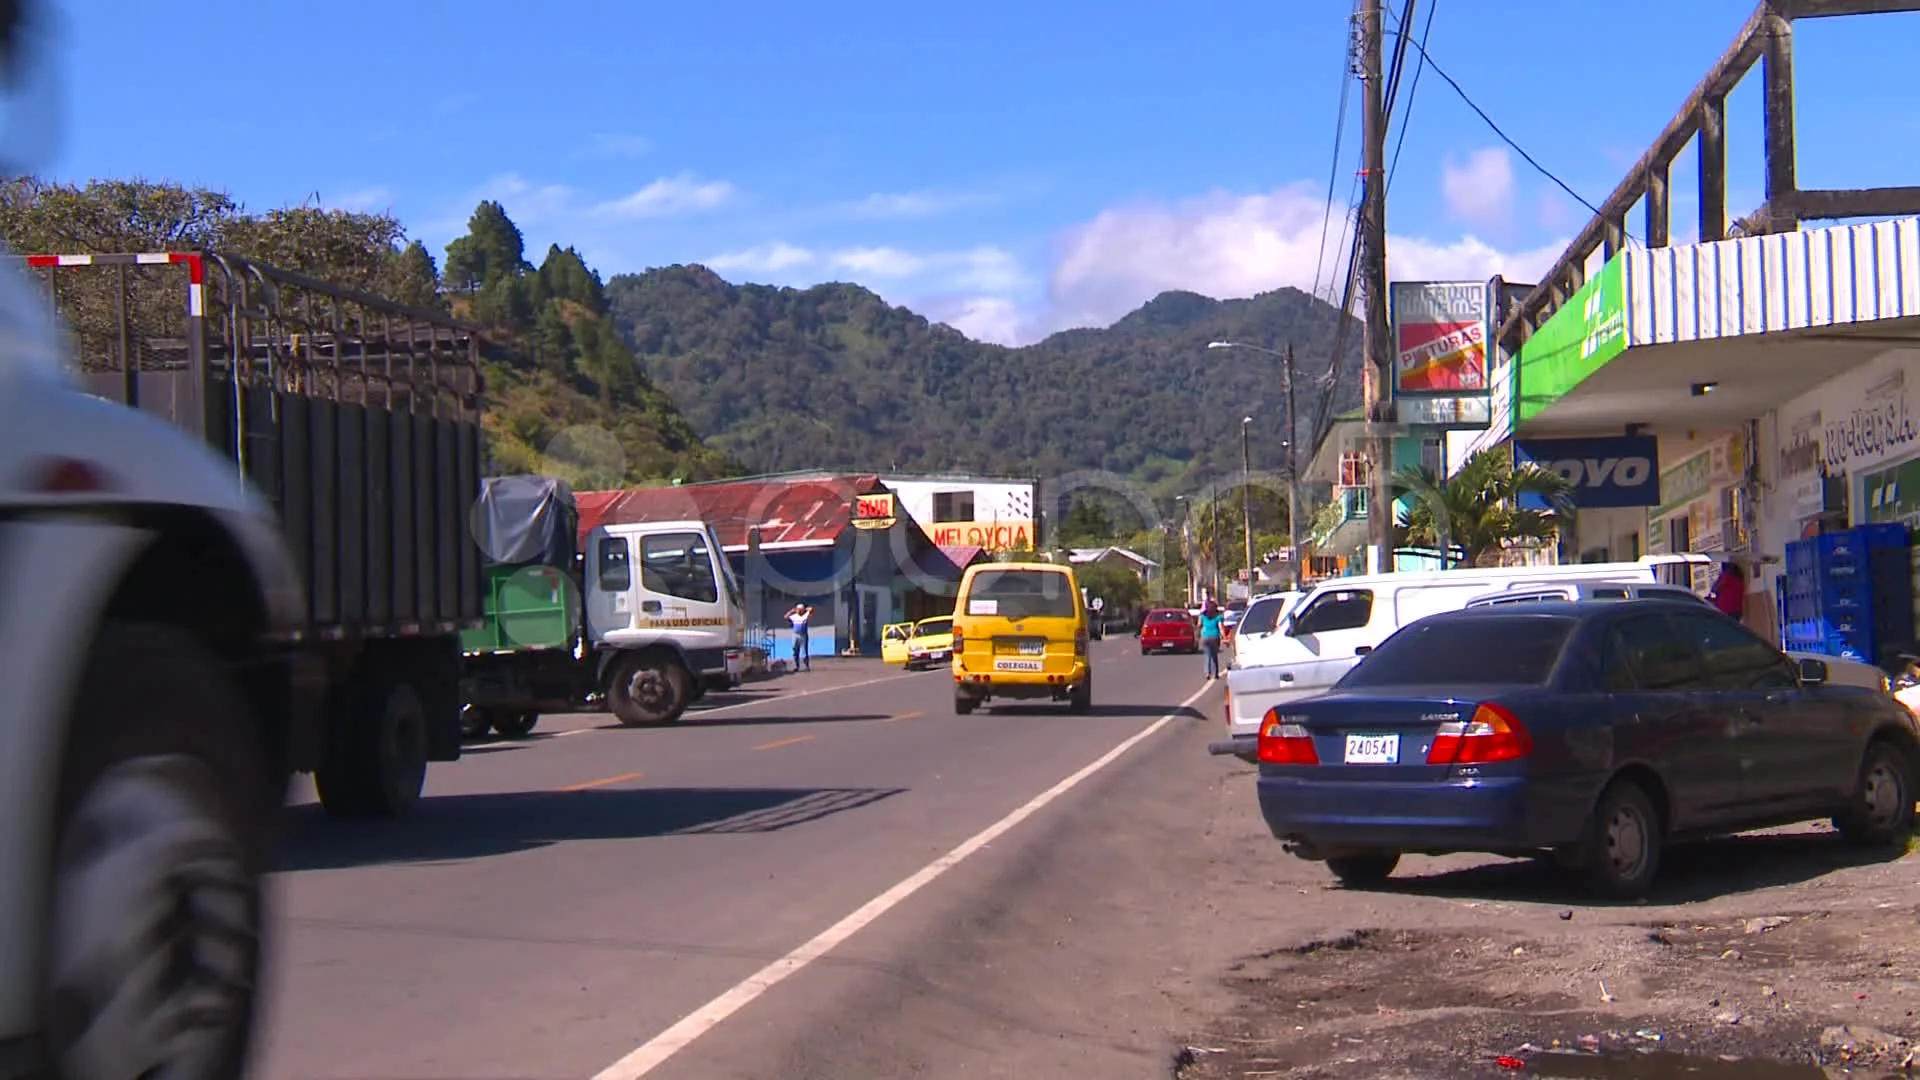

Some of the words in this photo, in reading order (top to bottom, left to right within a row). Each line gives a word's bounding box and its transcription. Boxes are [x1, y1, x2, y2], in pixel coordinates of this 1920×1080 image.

[1401, 327, 1482, 367] PITURAS
[1536, 456, 1650, 487] OYO
[672, 618, 689, 626] USO
[692, 617, 723, 626] OFICIAL
[997, 661, 1039, 670] COLEGIAL
[1349, 740, 1394, 756] 240541
